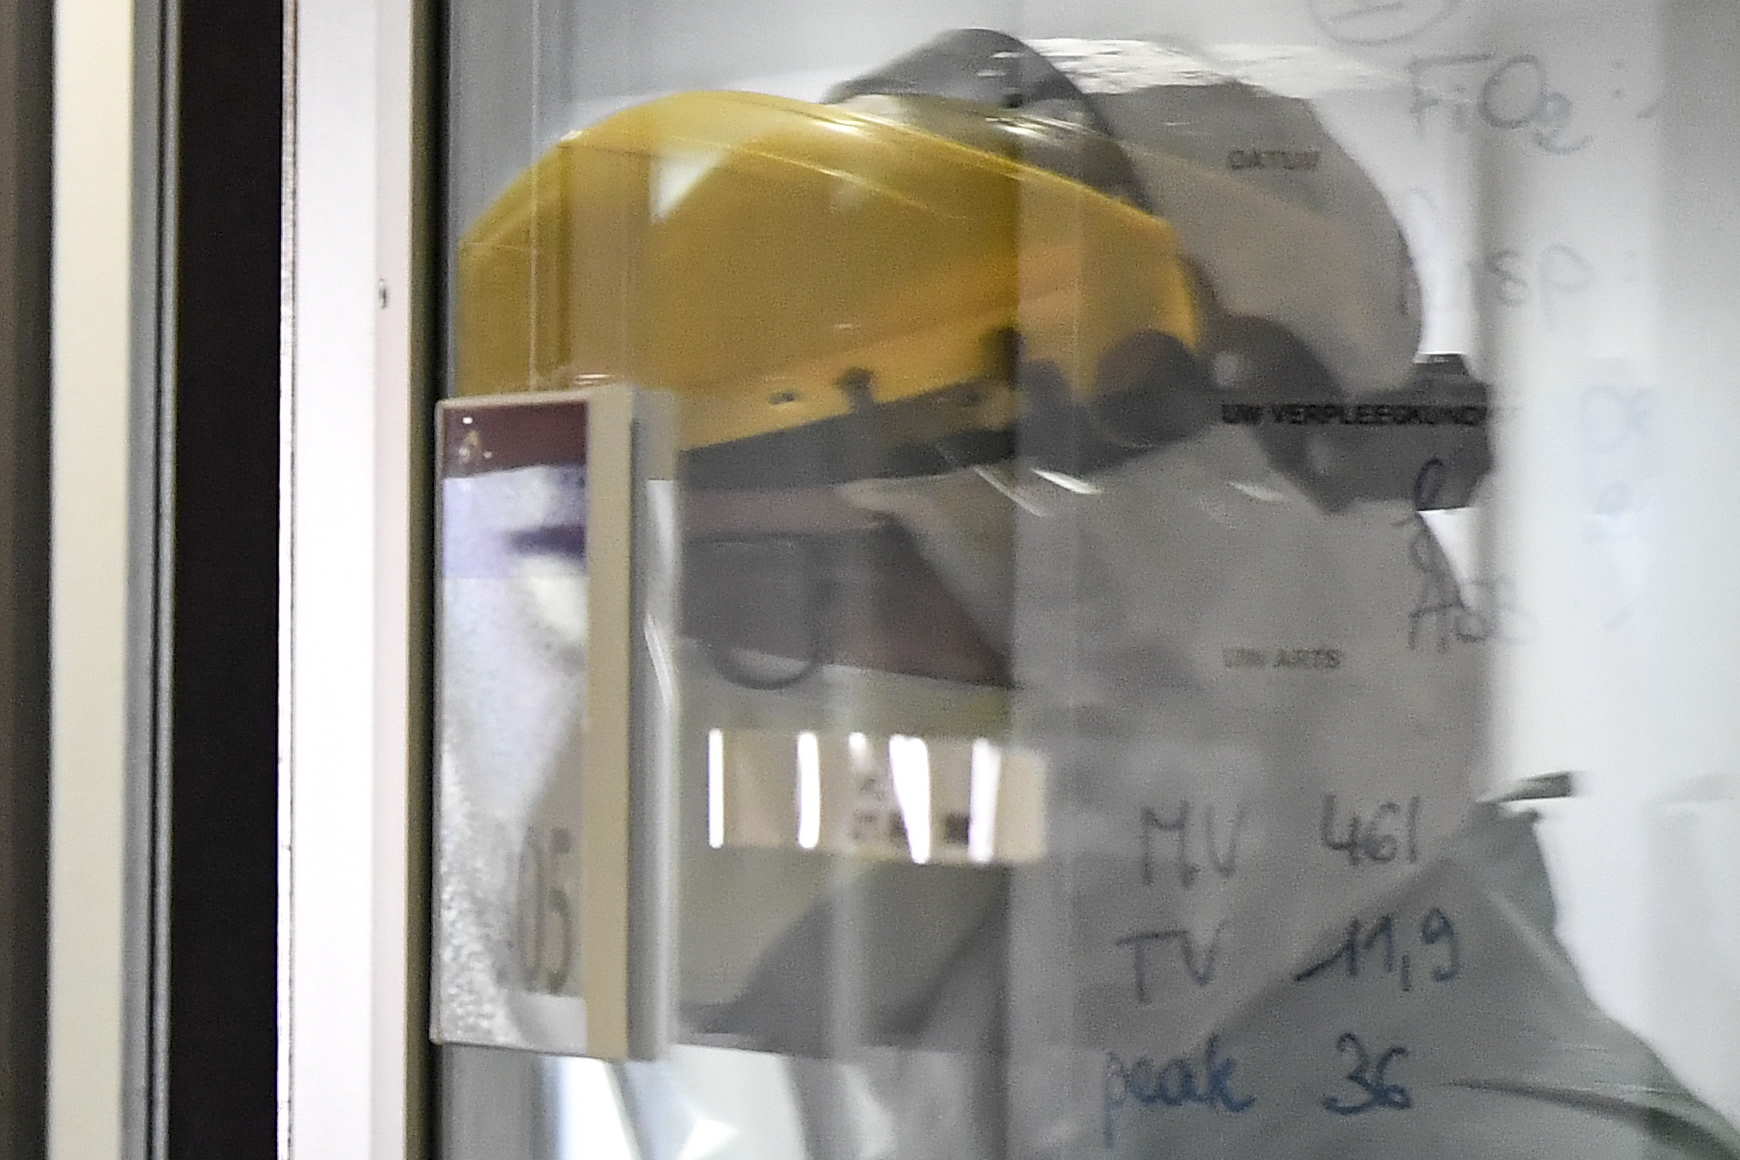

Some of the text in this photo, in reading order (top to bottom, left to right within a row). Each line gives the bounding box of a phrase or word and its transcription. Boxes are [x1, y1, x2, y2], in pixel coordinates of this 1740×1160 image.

[1222, 403, 1263, 425] UW
[1273, 648, 1343, 670] ARTS
[1103, 1031, 1413, 1148] peak 36
